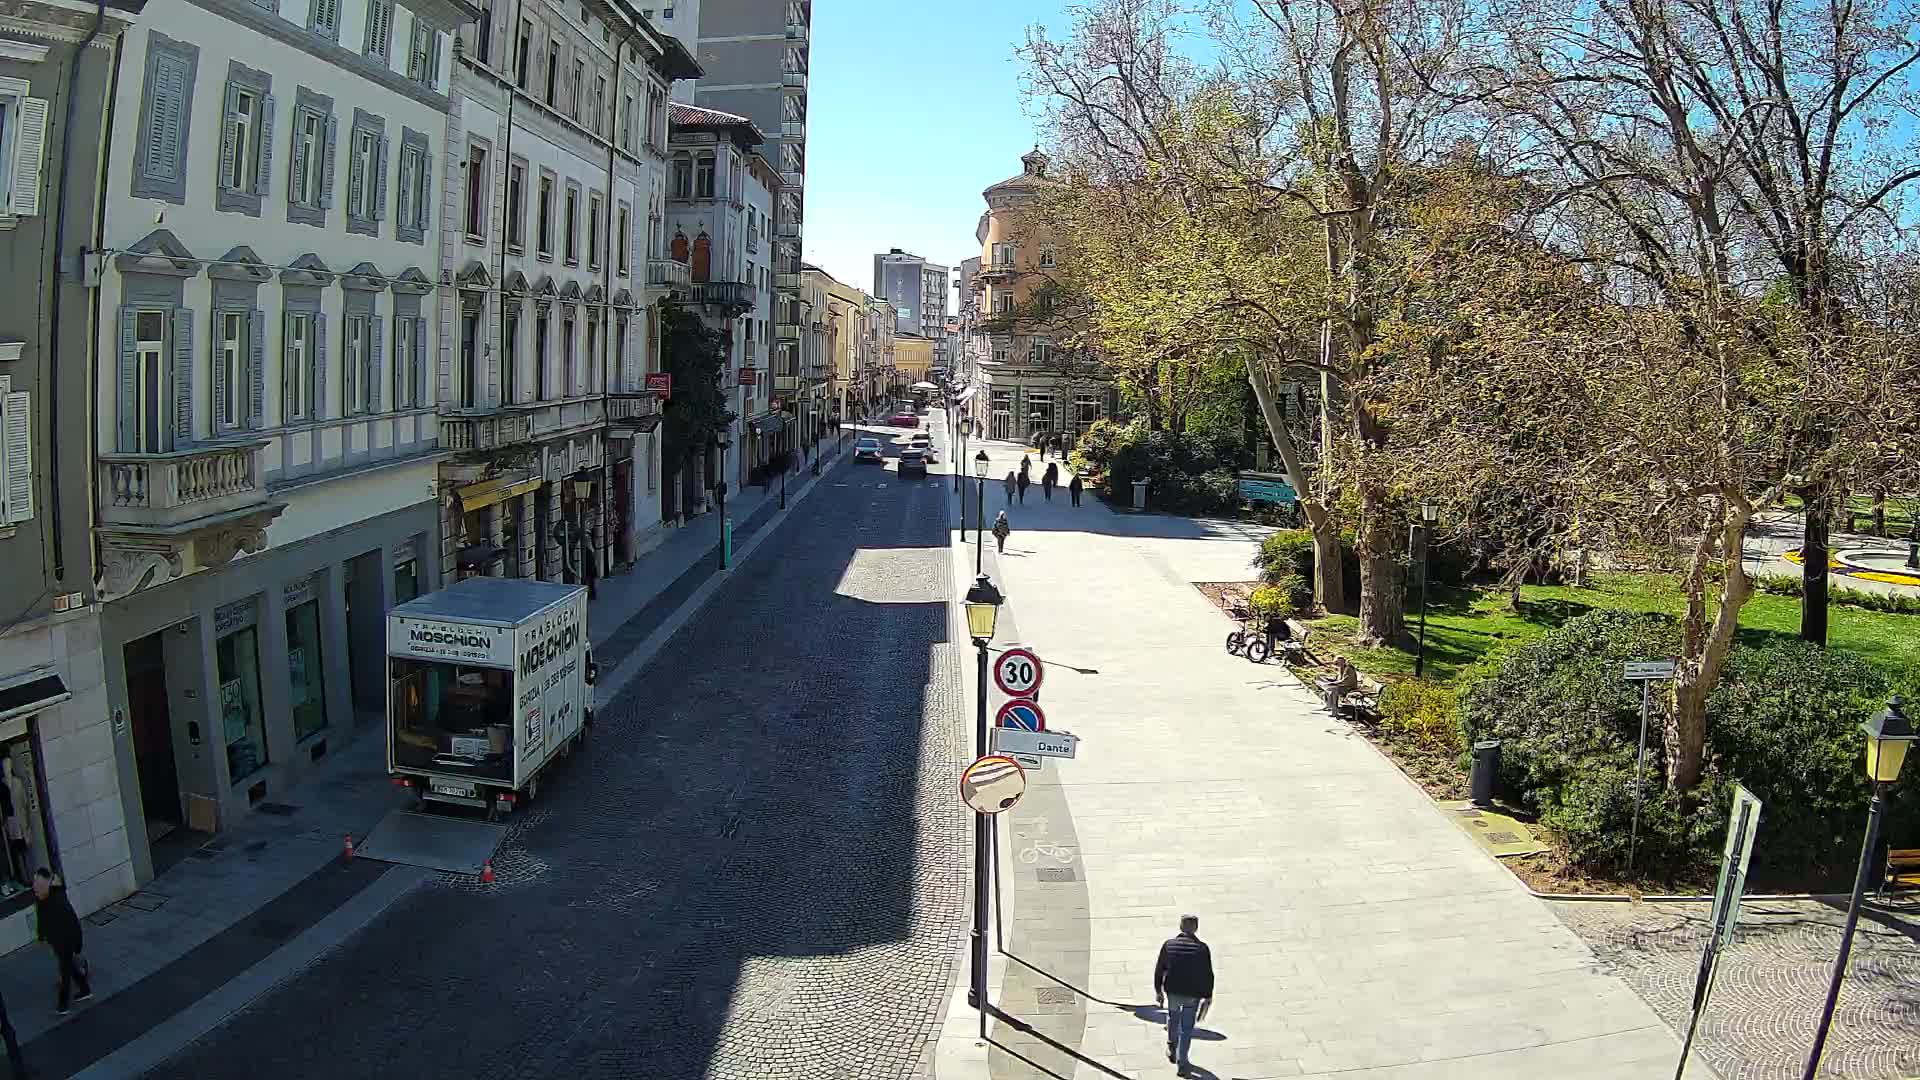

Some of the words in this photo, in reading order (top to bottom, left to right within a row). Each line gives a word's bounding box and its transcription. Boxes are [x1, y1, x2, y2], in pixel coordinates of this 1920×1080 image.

[524, 606, 577, 642] TRASLOCHI
[409, 629, 491, 649] MOSCHION
[1005, 661, 1033, 685] 30
[1038, 742, 1070, 753] Dante
